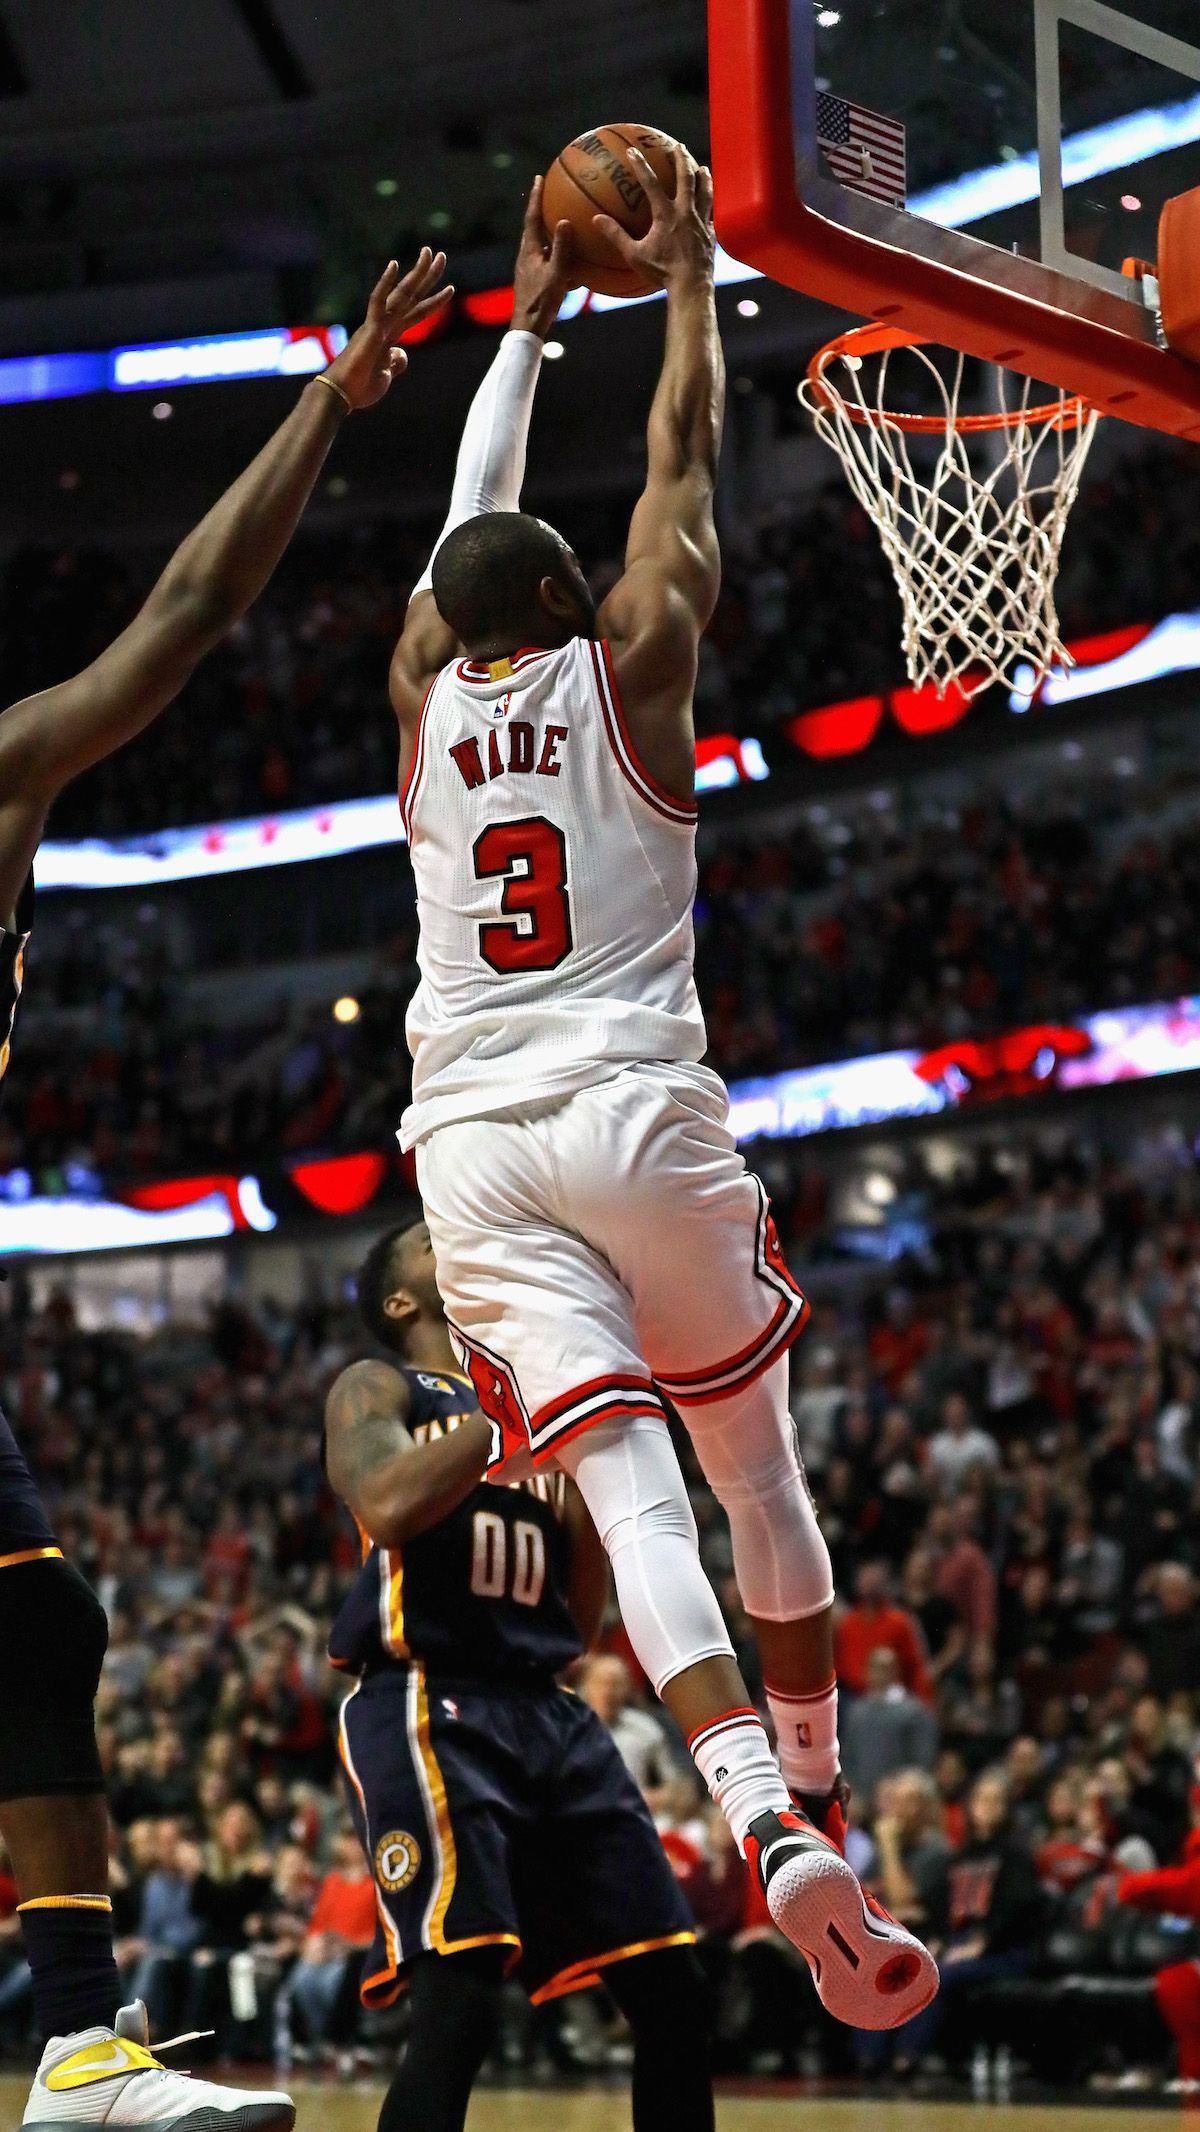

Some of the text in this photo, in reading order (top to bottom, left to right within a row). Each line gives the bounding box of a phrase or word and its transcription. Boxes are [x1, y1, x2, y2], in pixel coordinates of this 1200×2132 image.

[569, 132, 651, 213] SPALDIN
[448, 721, 569, 791] WADE
[471, 815, 575, 976] 3
[470, 1510, 546, 1608] 00
